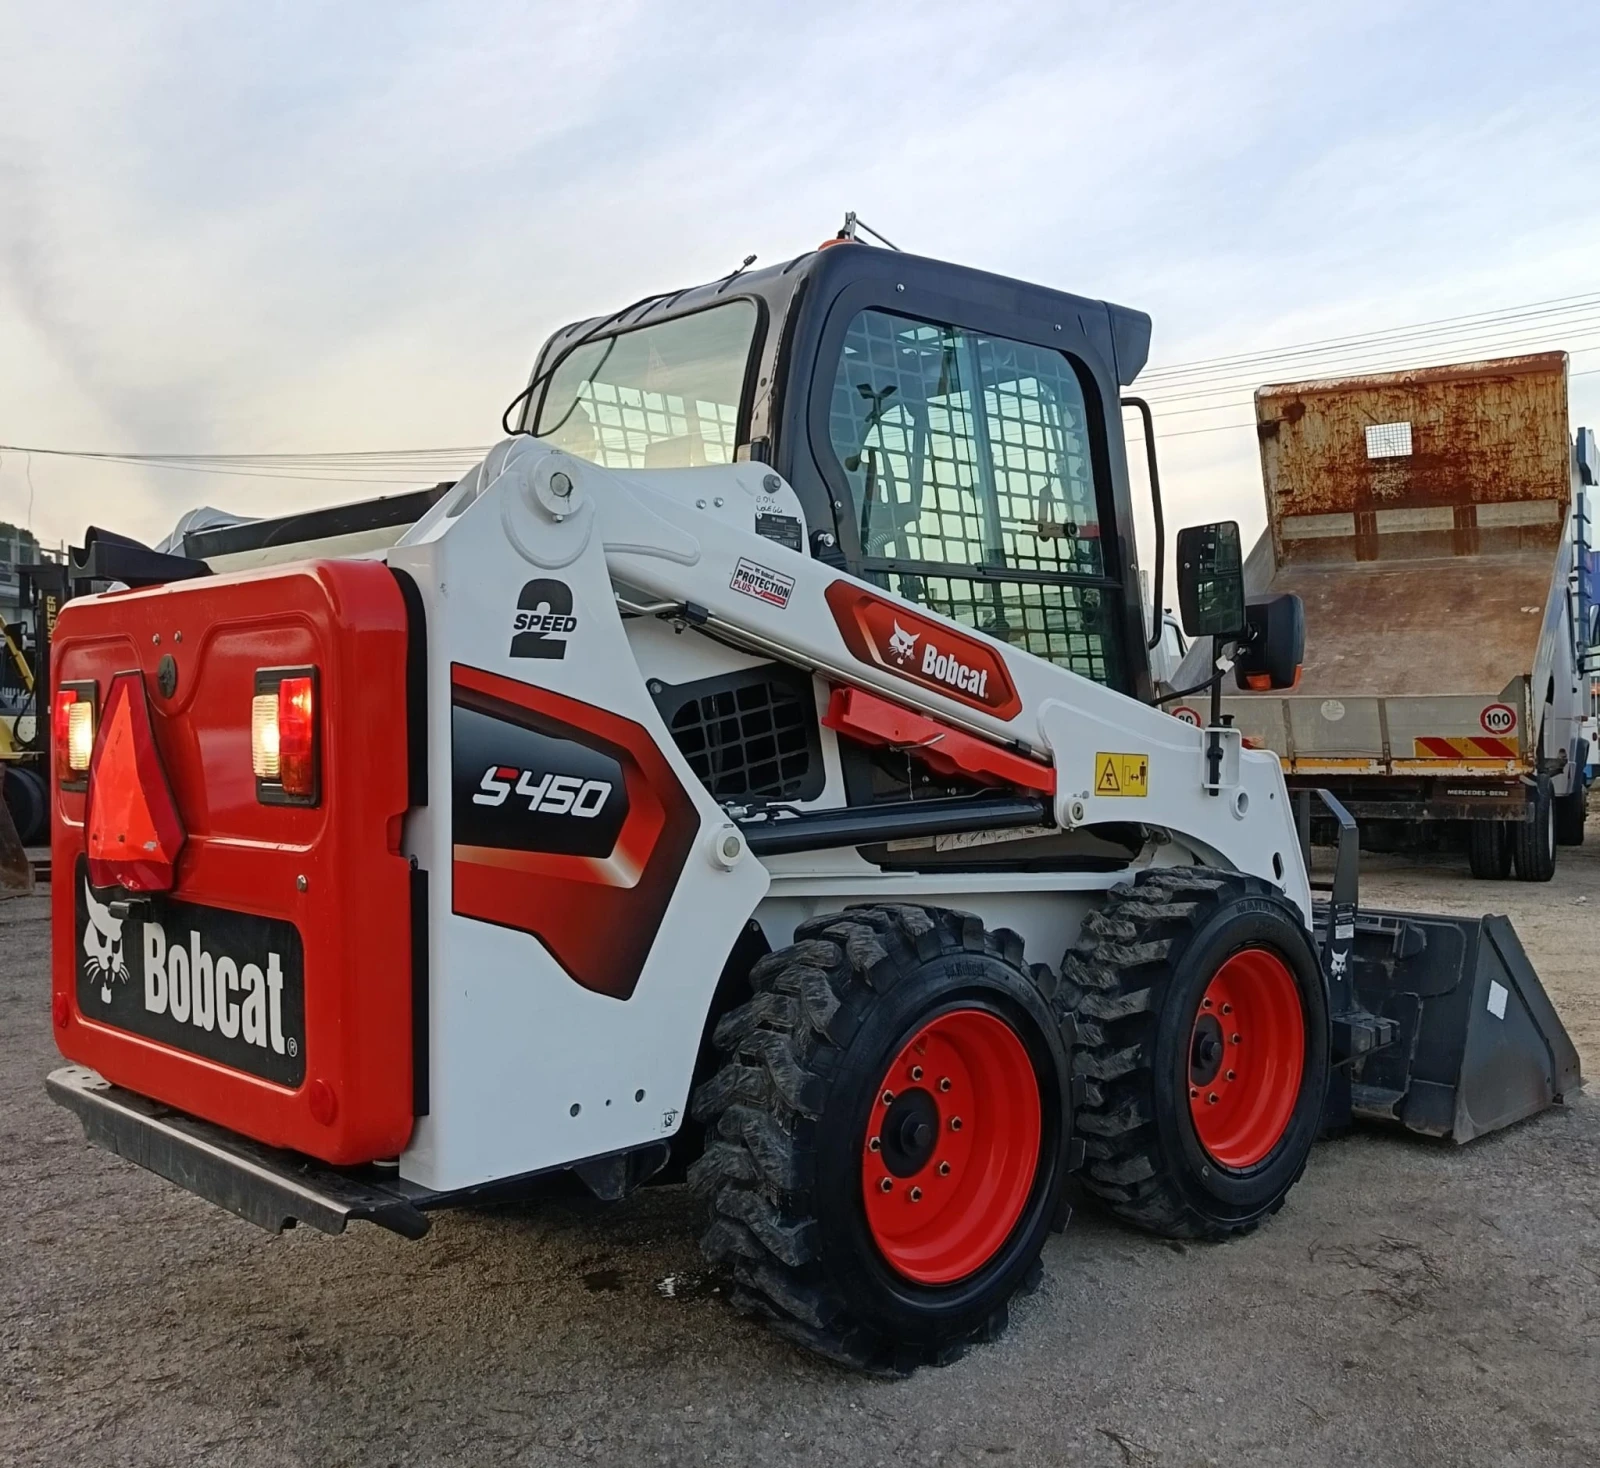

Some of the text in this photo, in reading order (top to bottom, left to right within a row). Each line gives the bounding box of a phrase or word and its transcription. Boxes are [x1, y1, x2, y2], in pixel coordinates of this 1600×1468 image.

[733, 579, 752, 593] PLUS
[736, 569, 790, 598] PROTECTION
[509, 578, 573, 660] 2
[513, 613, 577, 632] SPEED
[921, 643, 988, 698] Bobcat
[1486, 713, 1511, 727] 100
[472, 766, 613, 818] S450
[1447, 789, 1509, 797] MERCEDES-BENZ
